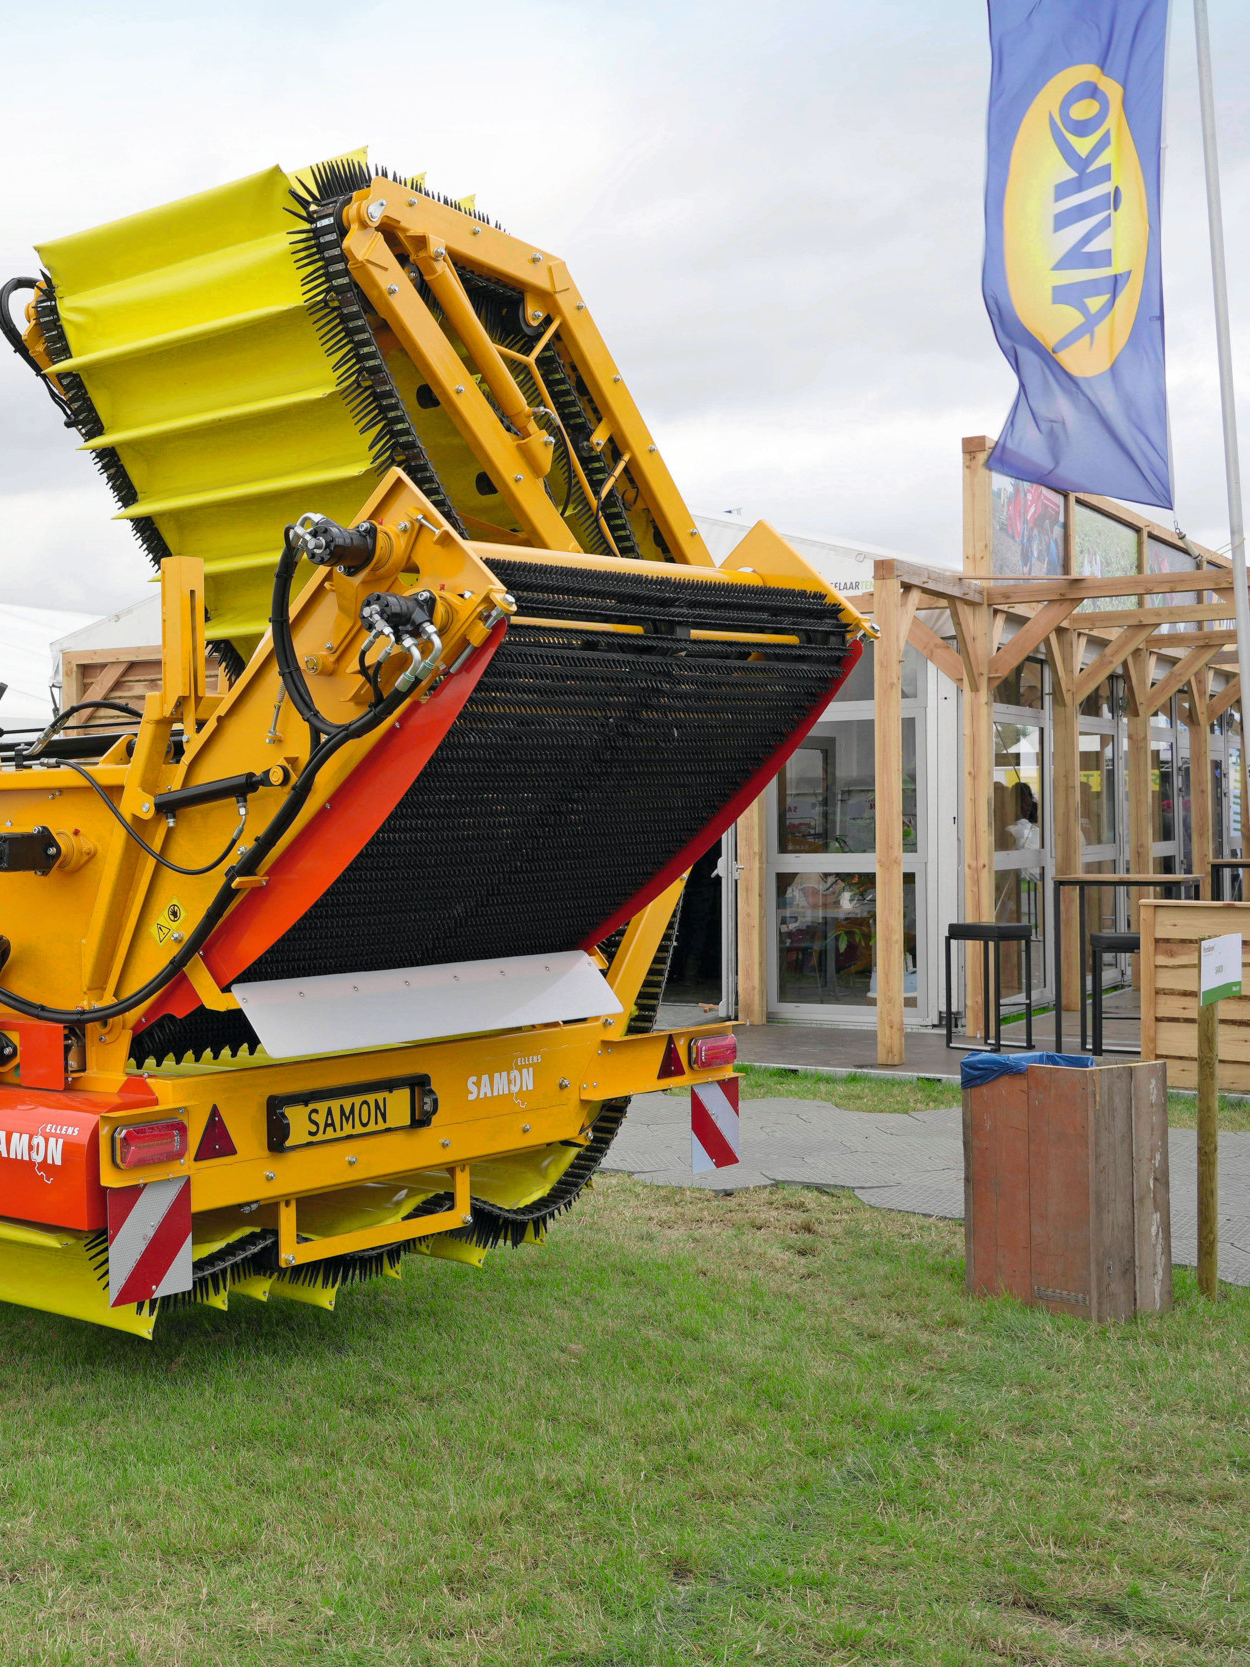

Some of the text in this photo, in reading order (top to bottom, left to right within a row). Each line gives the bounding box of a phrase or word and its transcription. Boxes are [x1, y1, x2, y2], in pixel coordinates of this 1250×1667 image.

[517, 1054, 542, 1066] ELLENS
[467, 1067, 534, 1101] SAMON
[307, 1096, 387, 1137] SAMON
[46, 1124, 80, 1136] ELLENS
